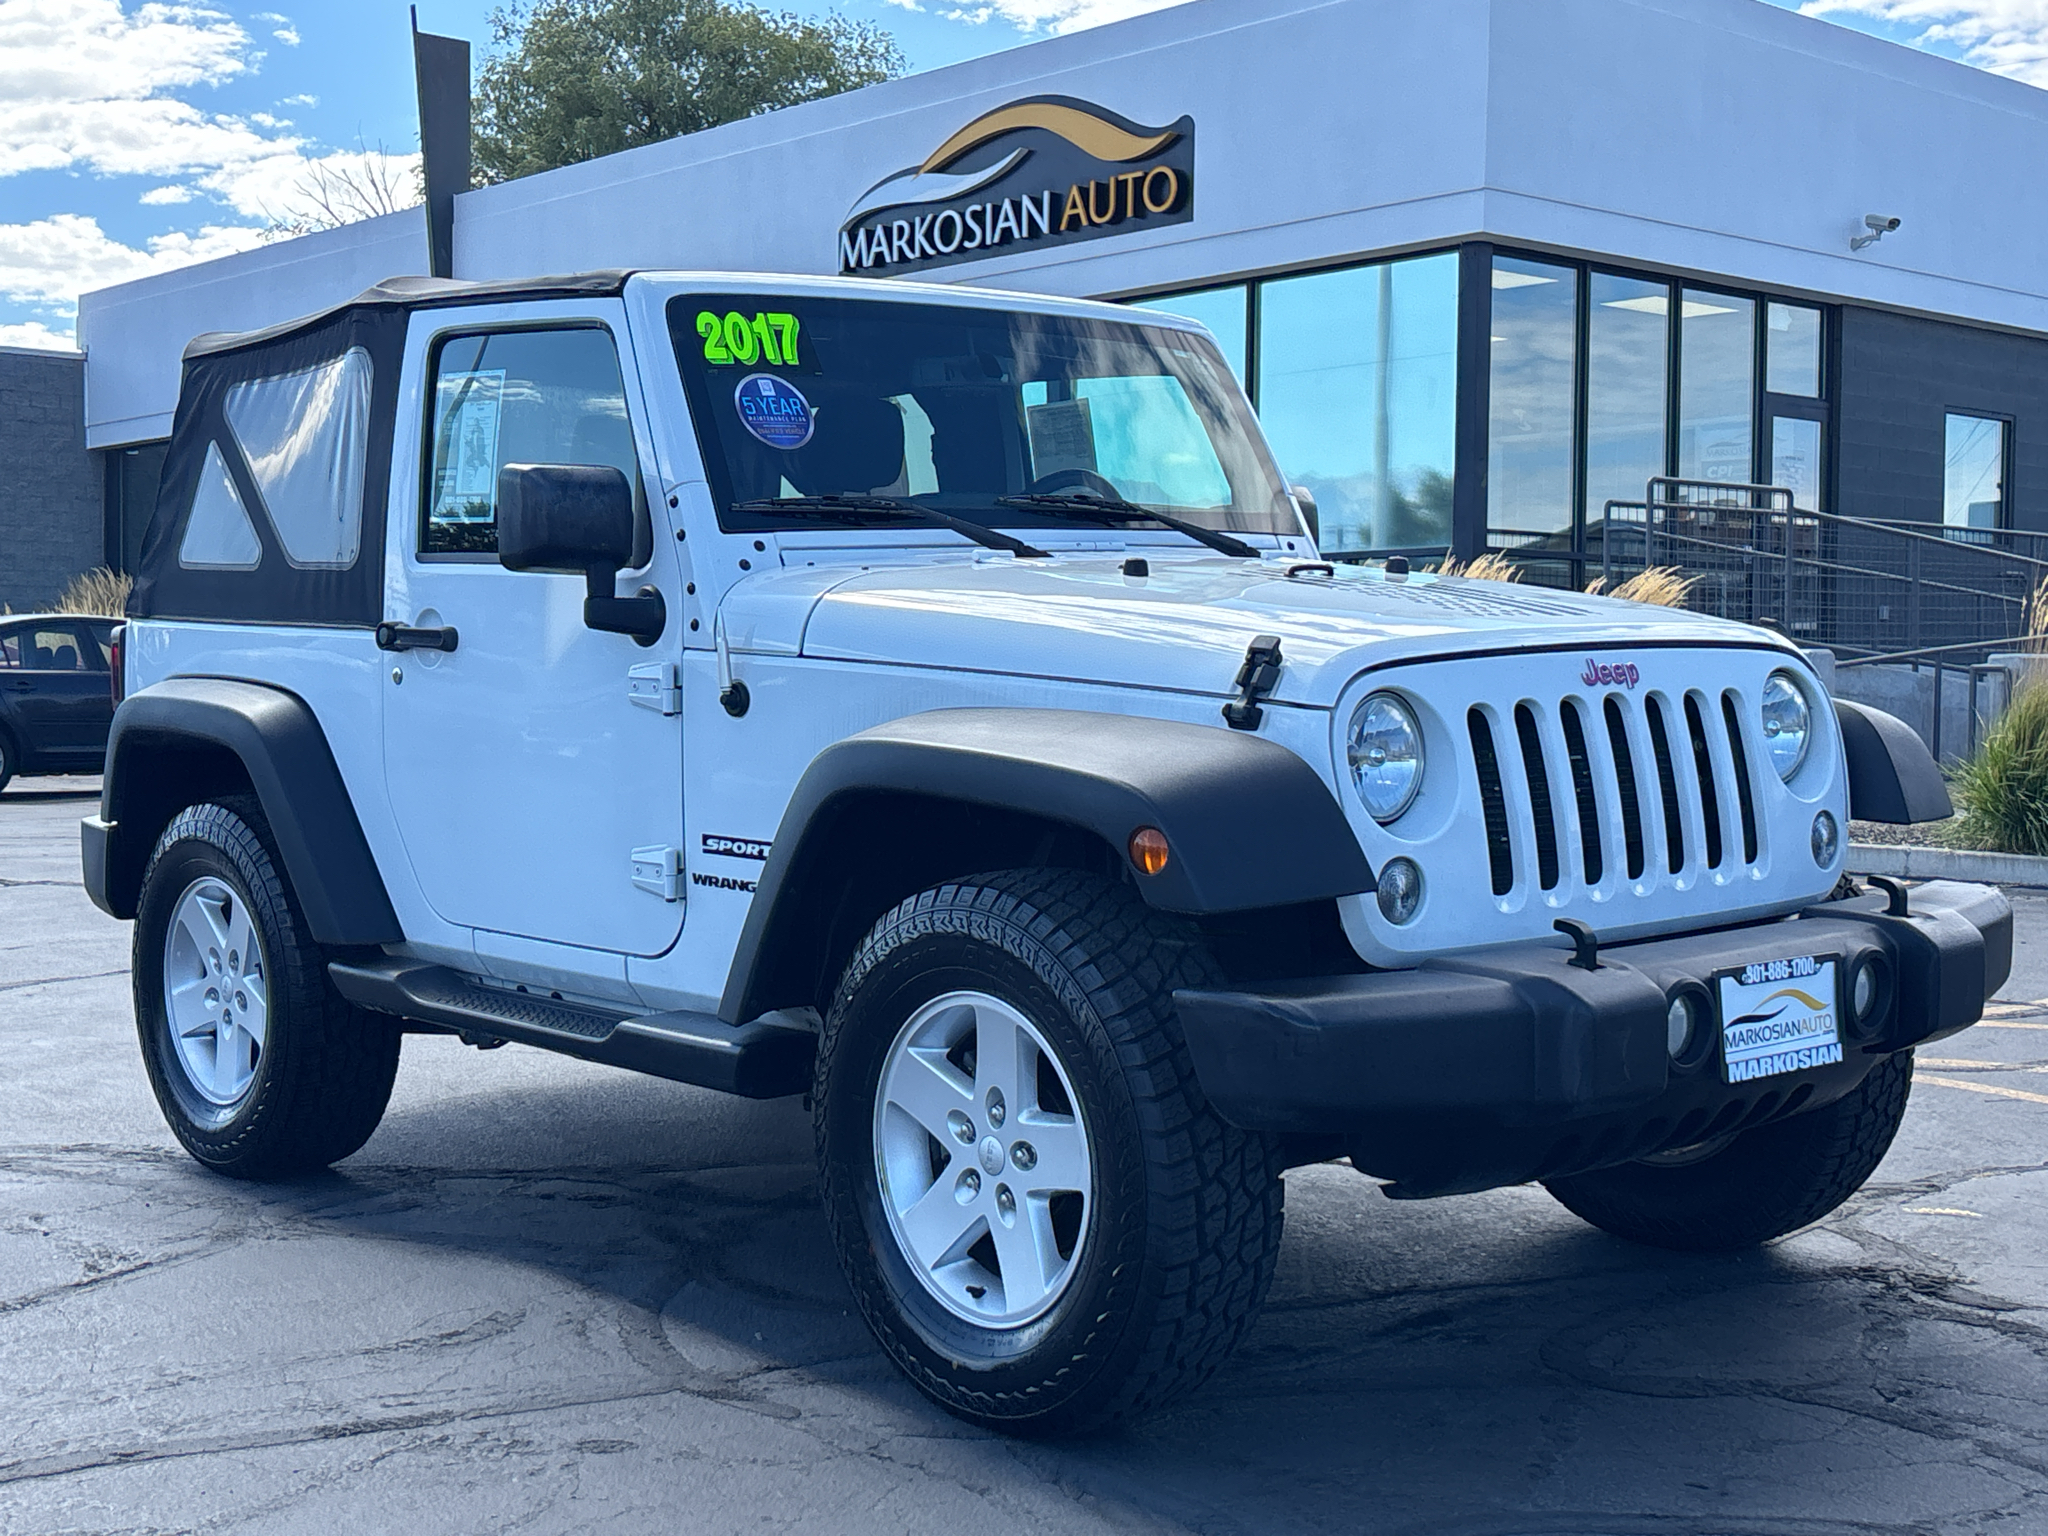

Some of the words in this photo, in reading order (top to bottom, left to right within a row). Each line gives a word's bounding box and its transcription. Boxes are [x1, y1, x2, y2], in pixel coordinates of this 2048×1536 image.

[838, 189, 1051, 271] MARKOSIAN
[1059, 166, 1178, 231] AUTO
[696, 311, 800, 366] 2017
[741, 396, 756, 415] 5
[756, 396, 805, 416] YEAR
[1581, 657, 1640, 690] Jeep
[706, 838, 772, 857] SPORT
[1728, 1043, 1843, 1083] MARKOSIAN
